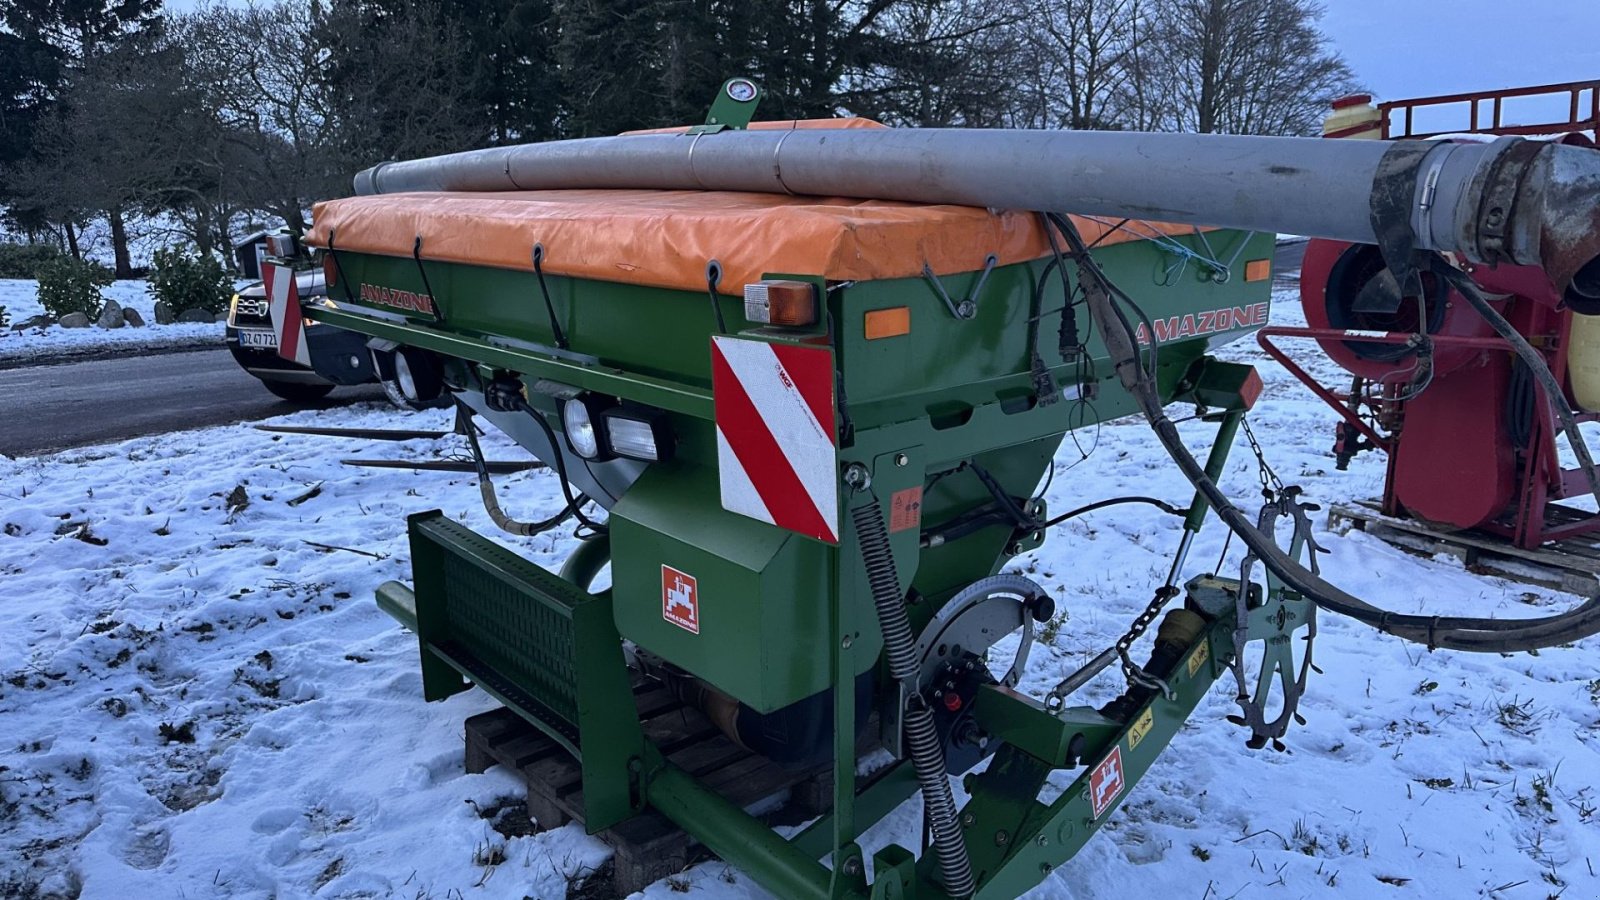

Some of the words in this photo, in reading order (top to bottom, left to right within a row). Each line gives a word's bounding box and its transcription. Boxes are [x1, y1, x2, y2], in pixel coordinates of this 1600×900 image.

[361, 283, 435, 315] AMAZONE
[1135, 302, 1268, 346] AMAZONE
[254, 334, 262, 345] 47
[665, 611, 697, 630] AMAZONE
